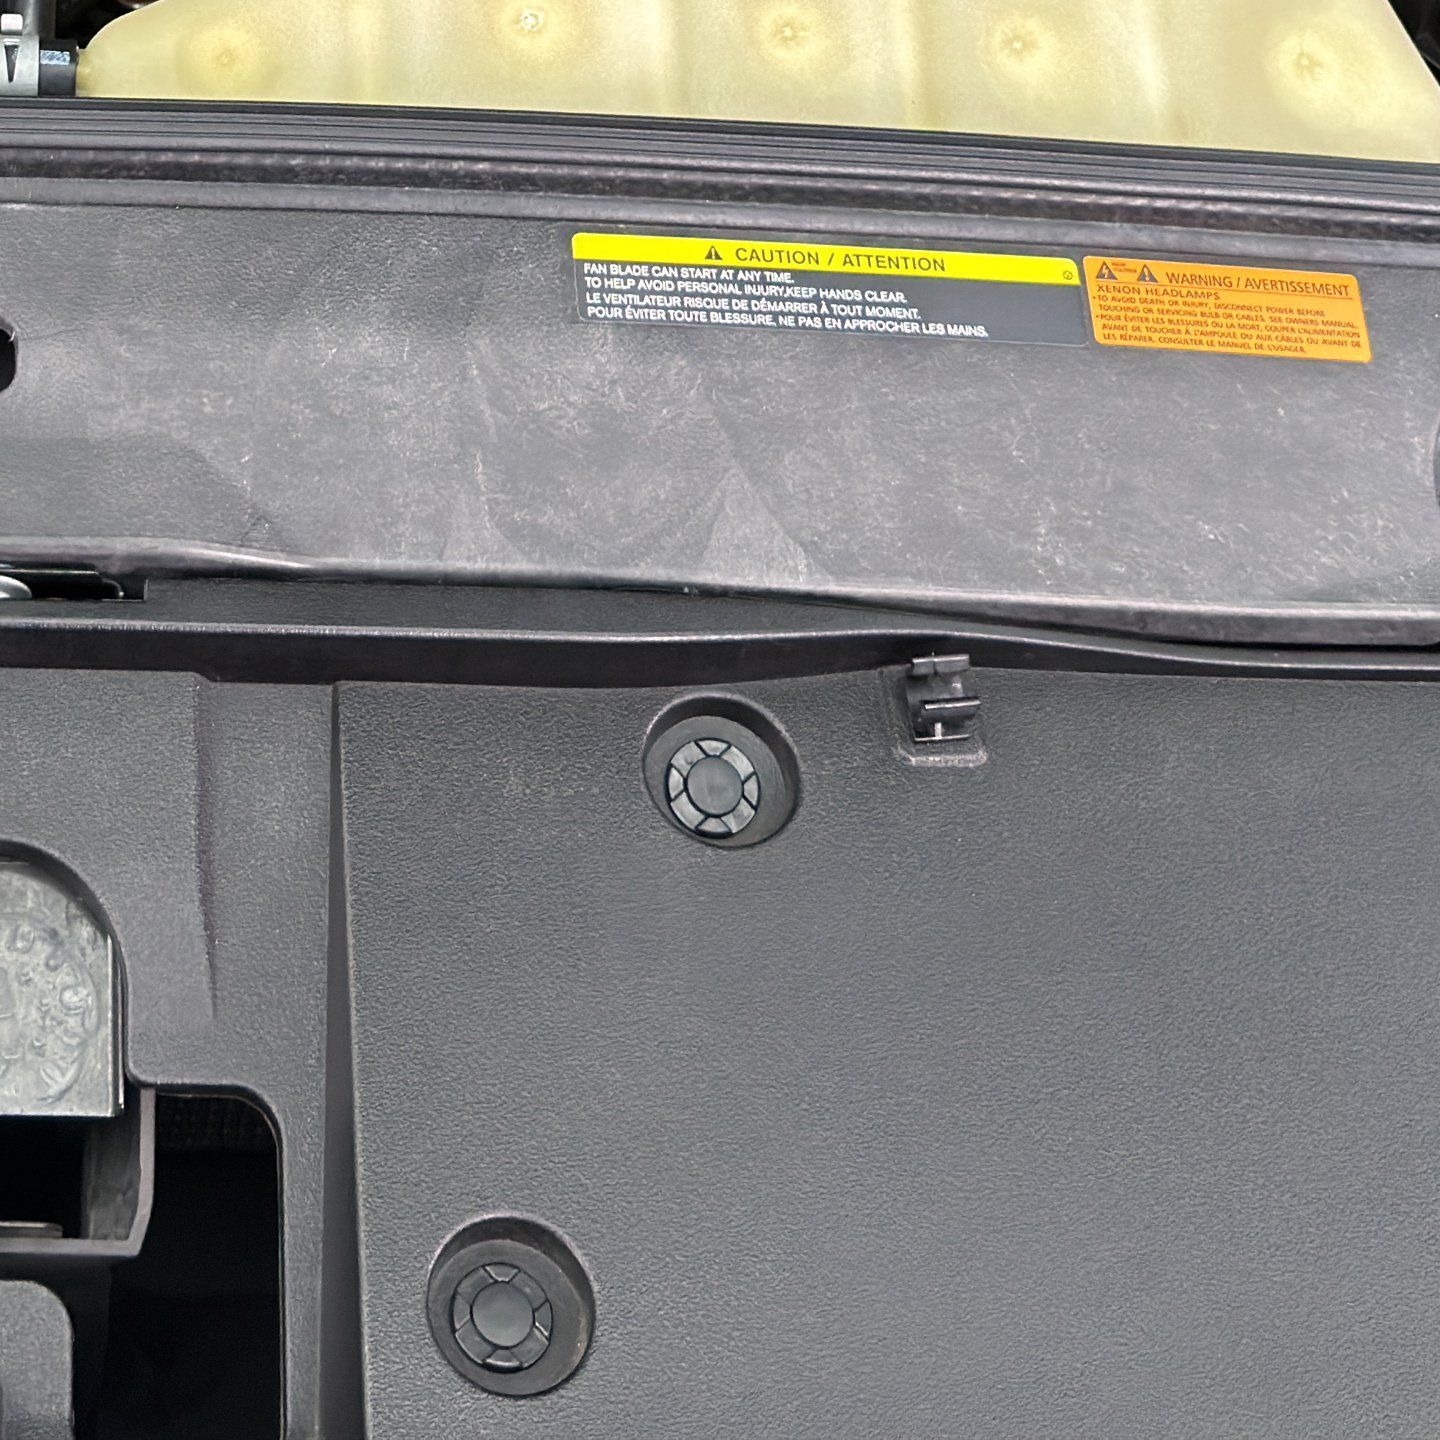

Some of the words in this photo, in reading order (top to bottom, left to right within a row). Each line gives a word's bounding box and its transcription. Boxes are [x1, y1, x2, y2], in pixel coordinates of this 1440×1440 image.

[735, 247, 820, 266] CAUTION
[827, 252, 835, 266] /
[842, 253, 946, 272] ATTENTION
[583, 262, 607, 274] FAN
[610, 263, 649, 277] BLADE
[651, 266, 678, 278] CAN
[680, 267, 718, 280] START
[720, 269, 734, 280] AT
[737, 270, 761, 282] ANY
[763, 271, 795, 283] TIME.
[1165, 271, 1233, 288] WARNING
[1236, 277, 1241, 289] /
[1244, 277, 1350, 297] AVERTISSEMENT
[585, 276, 602, 288] TO
[604, 277, 636, 290] HELP
[637, 279, 675, 292] AVOID
[677, 281, 742, 295] PERSONAL
[819, 288, 862, 301] HANDS
[864, 290, 907, 304] CLEAR.
[1096, 284, 1141, 295] XENON
[1145, 288, 1220, 301] HEADLAMPS
[1111, 296, 1136, 304] AVOID
[1139, 298, 1165, 306] DEATH
[586, 292, 601, 304] LE
[603, 293, 681, 307] VENTILATEUR
[684, 296, 729, 310] RISQUE
[731, 299, 748, 311] DE
[750, 298, 818, 314] DÉMARRER
[820, 300, 829, 315] À
[831, 303, 867, 317] TOUT
[869, 305, 922, 320] MOMENT.
[1098, 304, 1140, 314] TOUCHING
[1268, 316, 1283, 324] SEE
[587, 306, 623, 319] POUR
[625, 305, 666, 321] ÉVITER
[668, 309, 708, 322] TOUTE
[710, 311, 776, 327] BLESSURE,
[778, 315, 796, 327] NE
[798, 316, 822, 328] PAS
[824, 317, 842, 329] EN
[843, 318, 920, 333] APPROCHER
[922, 322, 945, 335] LES
[947, 323, 989, 337] MAINS.
[1100, 314, 1122, 322] POUR
[1152, 317, 1165, 325] LES
